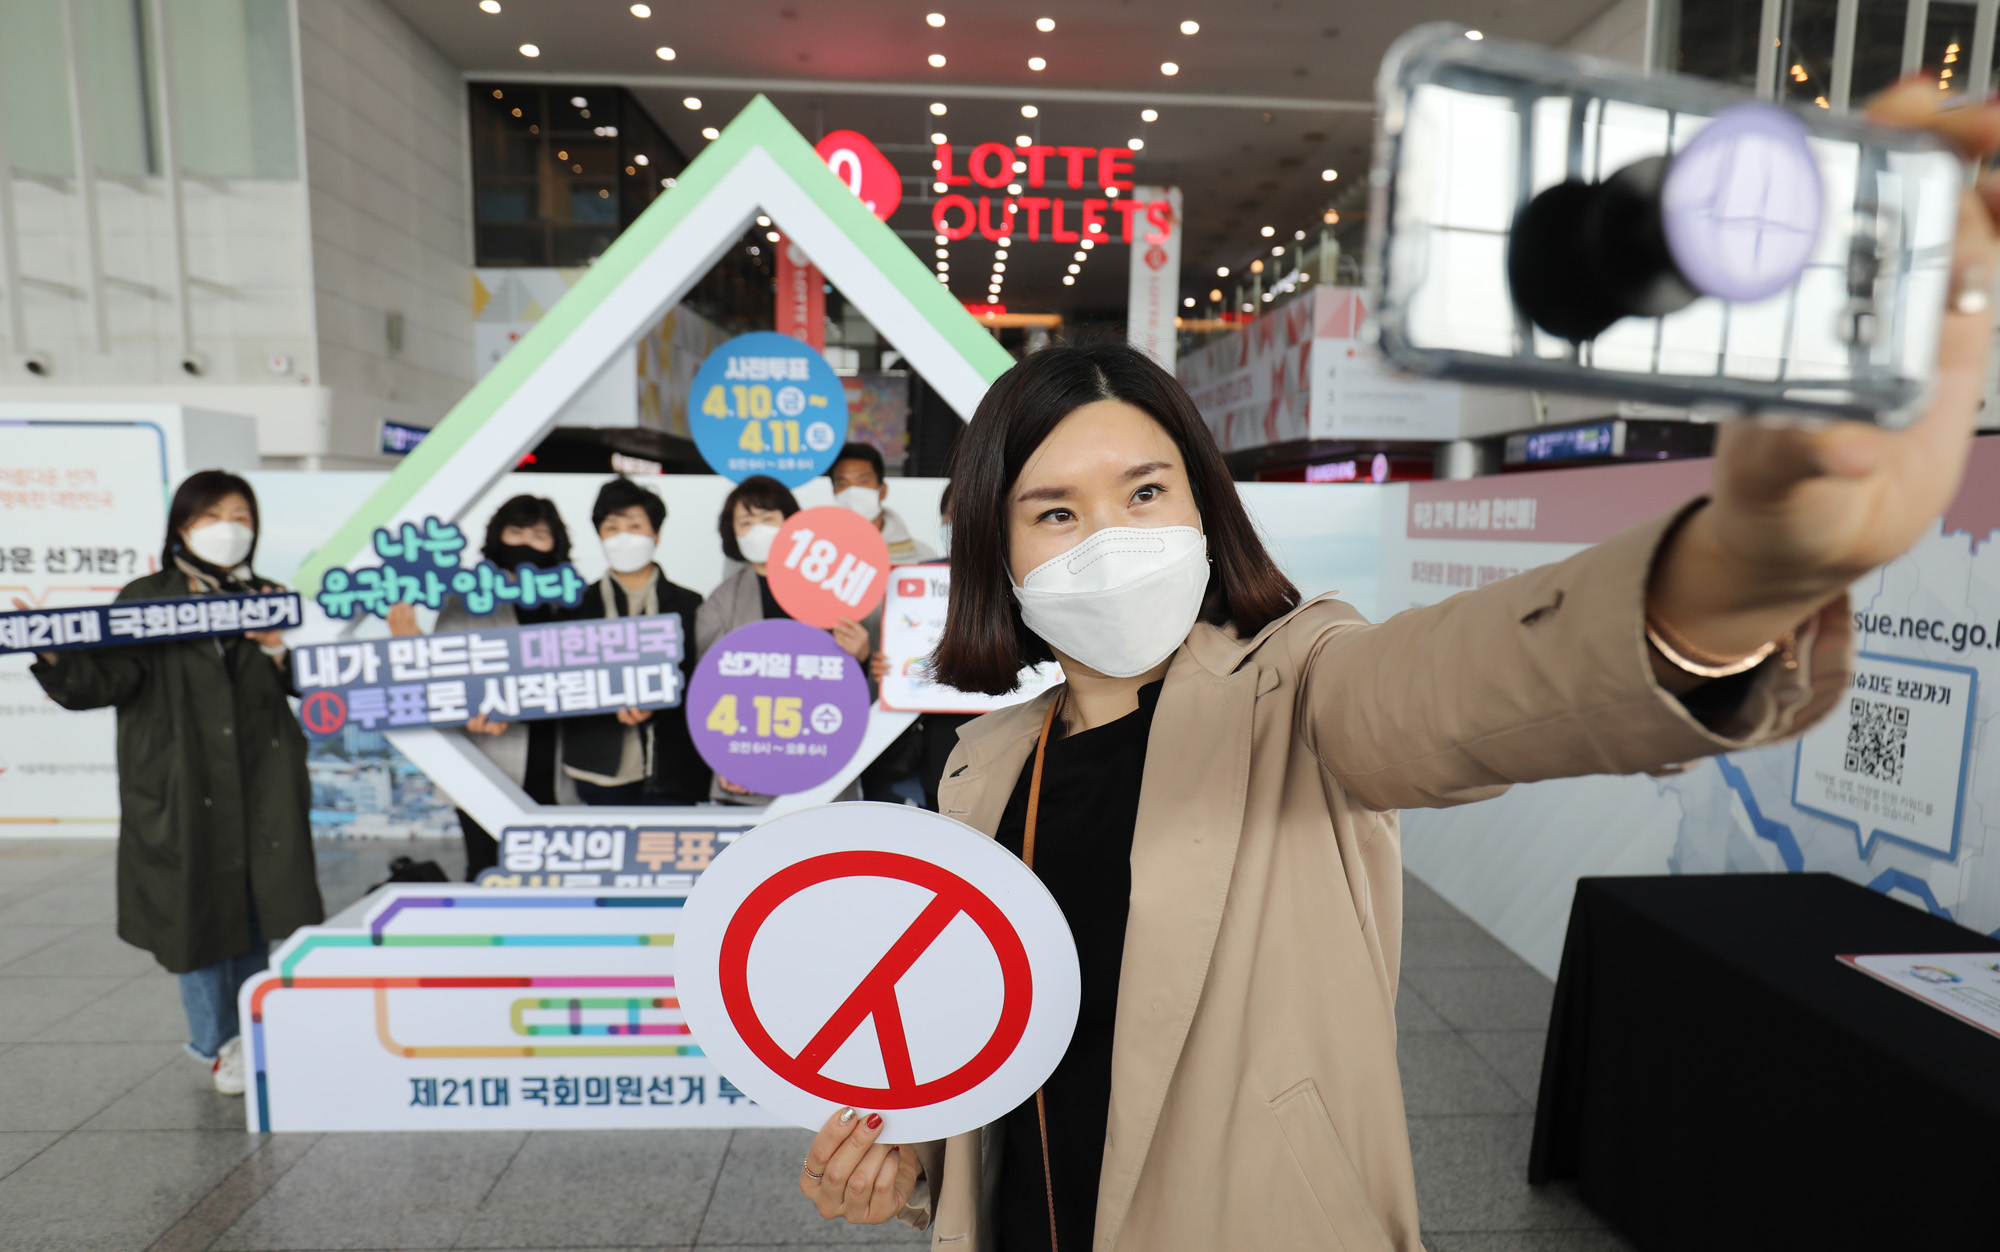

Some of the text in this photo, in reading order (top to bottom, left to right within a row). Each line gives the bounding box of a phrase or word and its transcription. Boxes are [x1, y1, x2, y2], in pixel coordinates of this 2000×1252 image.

[935, 142, 1135, 190] LOTTE
[932, 194, 1172, 245] OUTLETS
[724, 356, 810, 381] 사전투표
[45, 547, 137, 574] 선거란?
[375, 517, 466, 567] 나는
[319, 564, 583, 617] 유권자 입니다
[784, 528, 878, 607] 18세
[0, 595, 300, 649] 제21대 국회의원선거
[297, 618, 678, 688] 내가 만드는 대한민국
[717, 651, 844, 681] 선거일 투표
[347, 664, 679, 729] 투표로 시작됩니다
[1896, 679, 1952, 705] 보러가기
[504, 830, 749, 872] 당신의 투표
[408, 1075, 758, 1107] 제21대 국회의원선거 투
